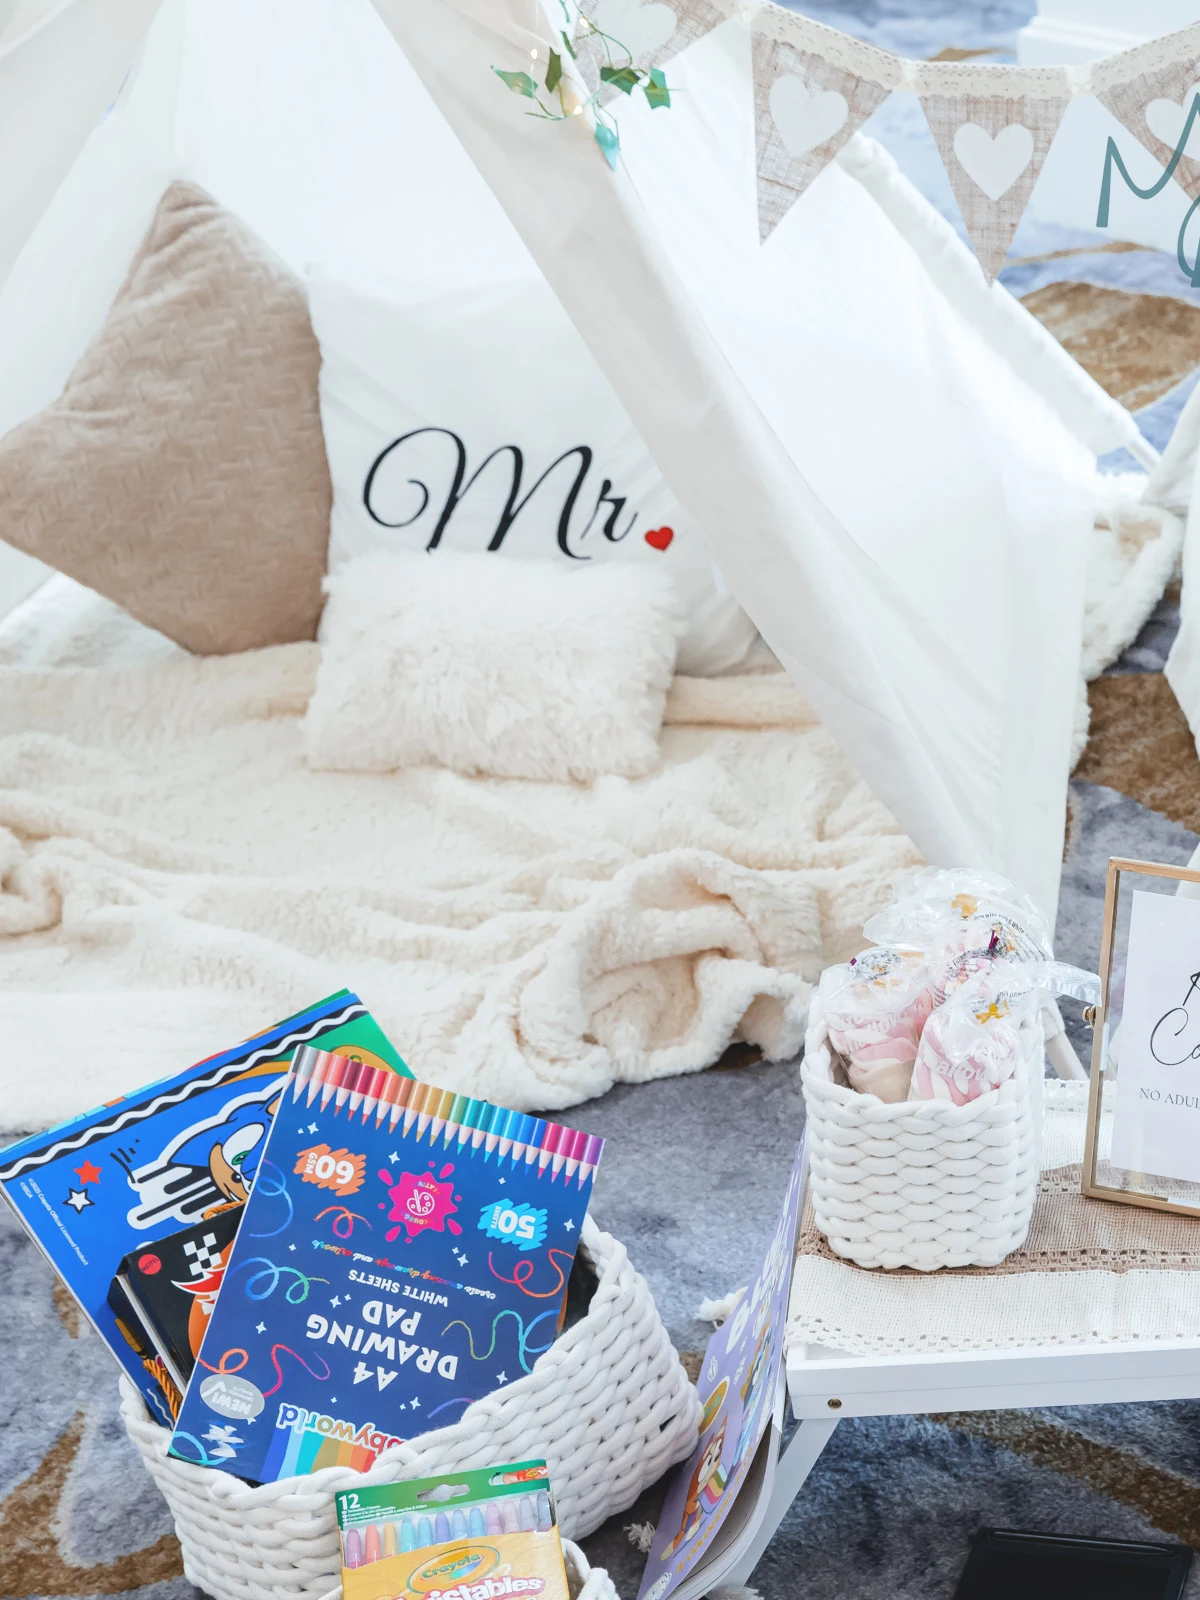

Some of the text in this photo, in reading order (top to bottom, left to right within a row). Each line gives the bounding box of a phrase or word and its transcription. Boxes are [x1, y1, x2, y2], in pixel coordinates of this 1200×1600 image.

[1139, 1087, 1162, 1103] NO
[303, 1152, 317, 1175] GSM
[316, 1156, 355, 1185] 60
[490, 1205, 502, 1229] SHEETS
[498, 1209, 536, 1240] 50
[311, 1240, 353, 1257] artwork
[352, 1252, 374, 1264] and
[140, 1256, 159, 1273] MATTEL
[375, 1258, 420, 1278] drawings
[348, 1269, 448, 1308] WHITE SHEETS
[464, 1286, 496, 1300] create
[362, 1300, 422, 1337] PAD
[306, 1313, 458, 1380] DRAWING
[353, 1361, 398, 1392] A4
[211, 1393, 251, 1416] NEW!
[339, 1494, 361, 1508] 12
[422, 1553, 481, 1579] Crayola
